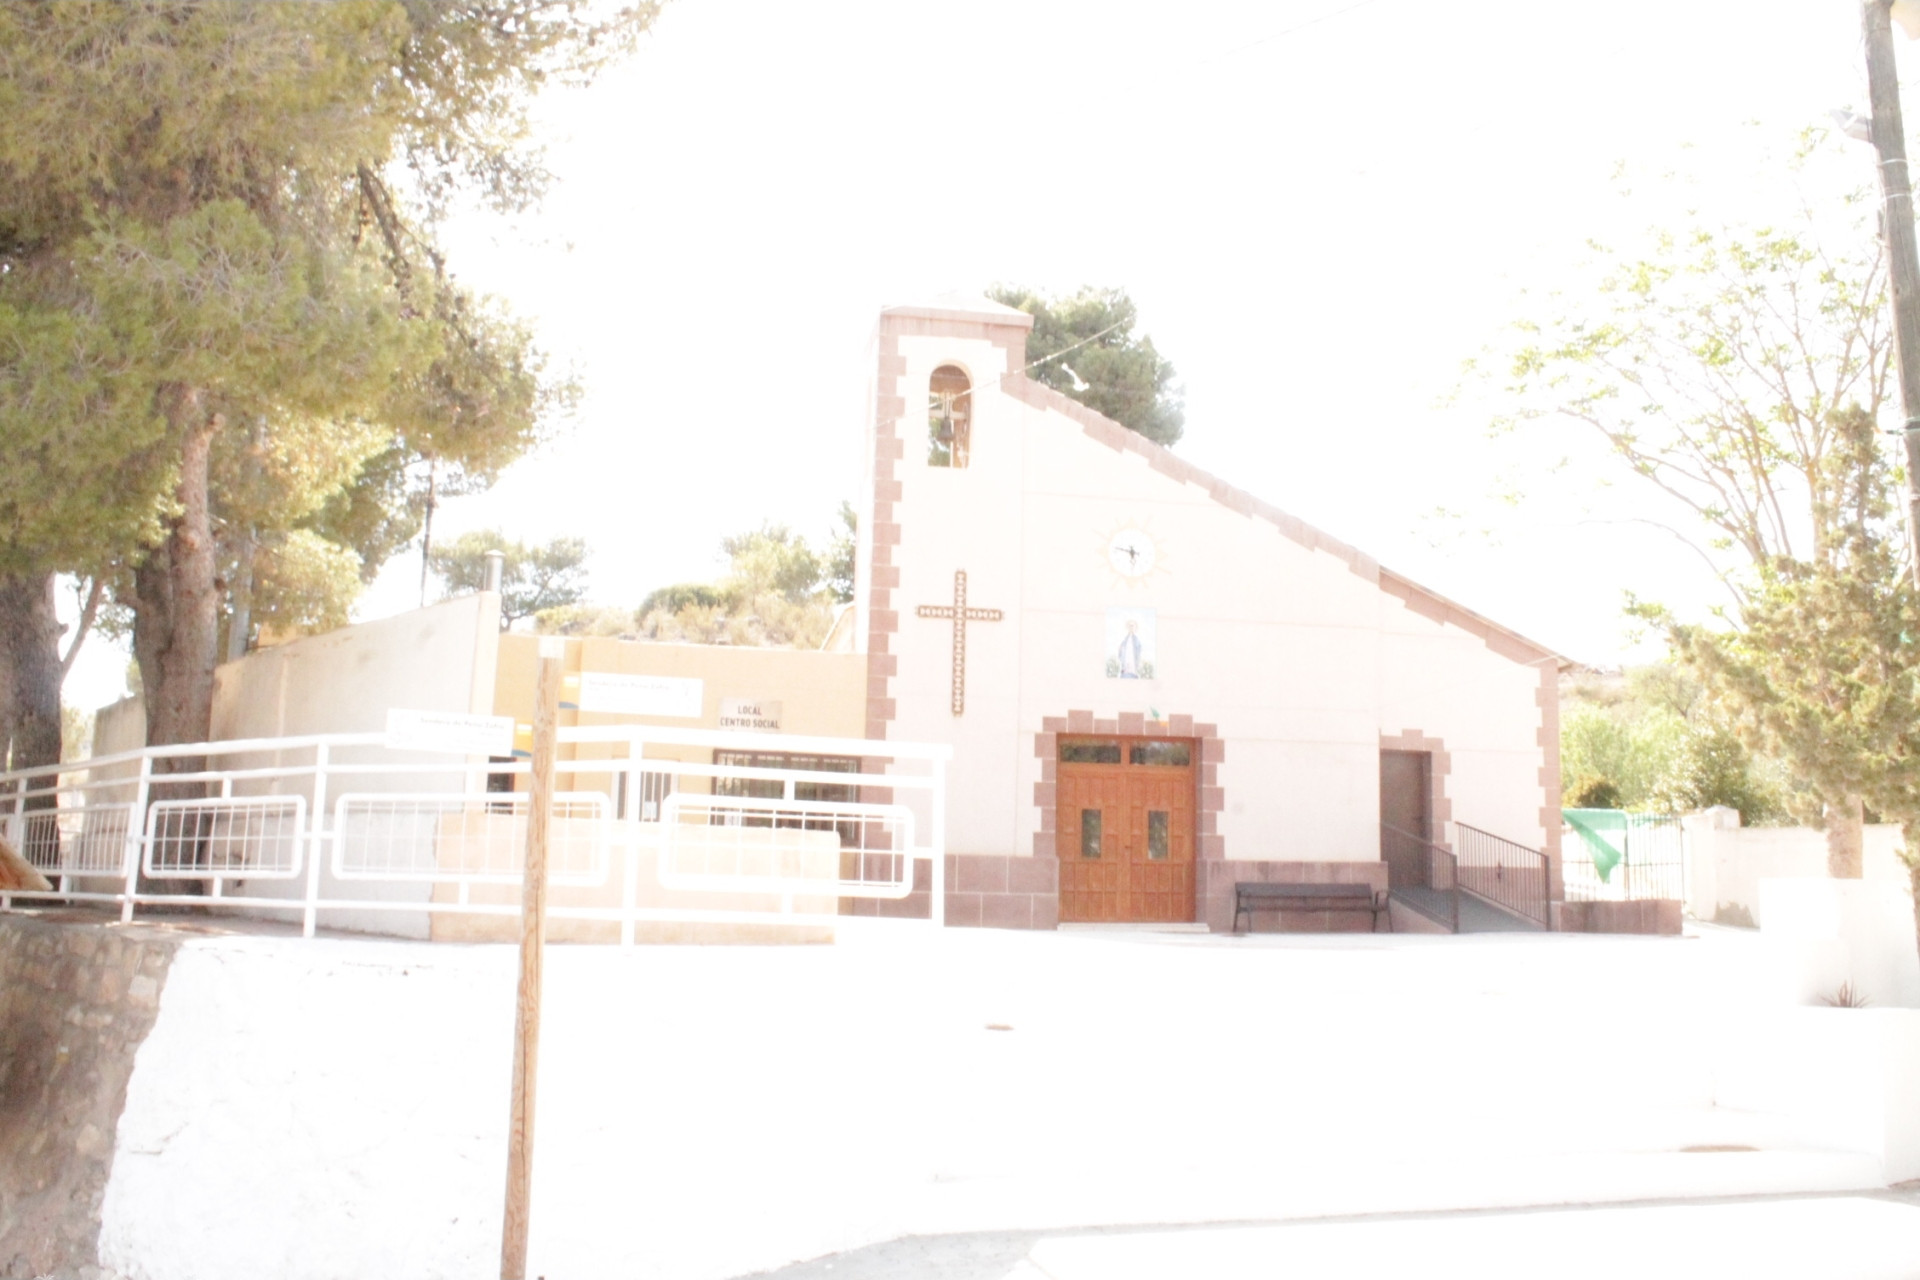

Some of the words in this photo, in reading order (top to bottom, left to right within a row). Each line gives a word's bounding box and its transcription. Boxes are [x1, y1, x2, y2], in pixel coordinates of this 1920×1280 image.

[737, 705, 762, 716] LOCAL
[720, 717, 751, 728] CENTRO
[753, 718, 780, 729] SOCIAL
